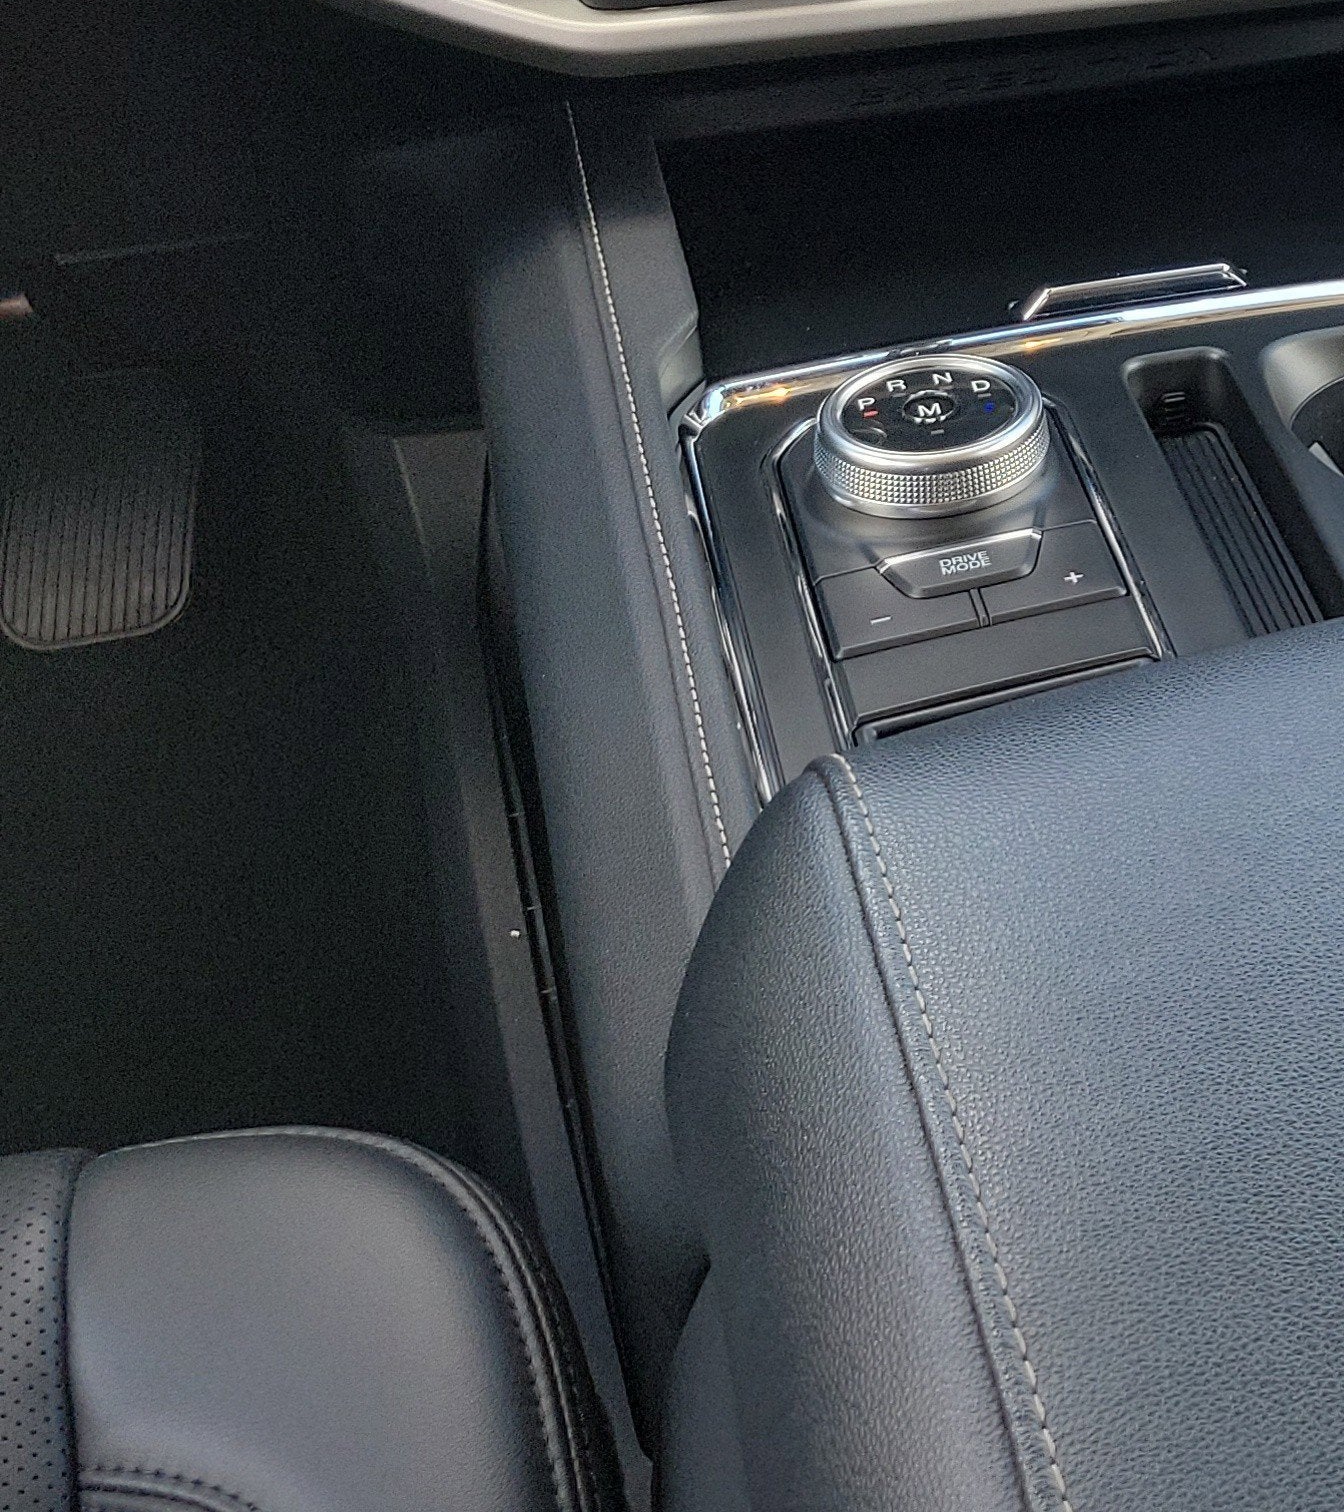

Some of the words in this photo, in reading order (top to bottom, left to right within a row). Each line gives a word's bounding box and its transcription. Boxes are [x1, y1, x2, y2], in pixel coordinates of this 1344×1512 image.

[886, 379, 906, 392] R
[932, 371, 953, 386] N
[971, 379, 990, 393] D
[857, 397, 877, 411] P
[917, 402, 942, 417] M
[939, 550, 989, 568] DRIVE
[941, 559, 992, 576] MODE
